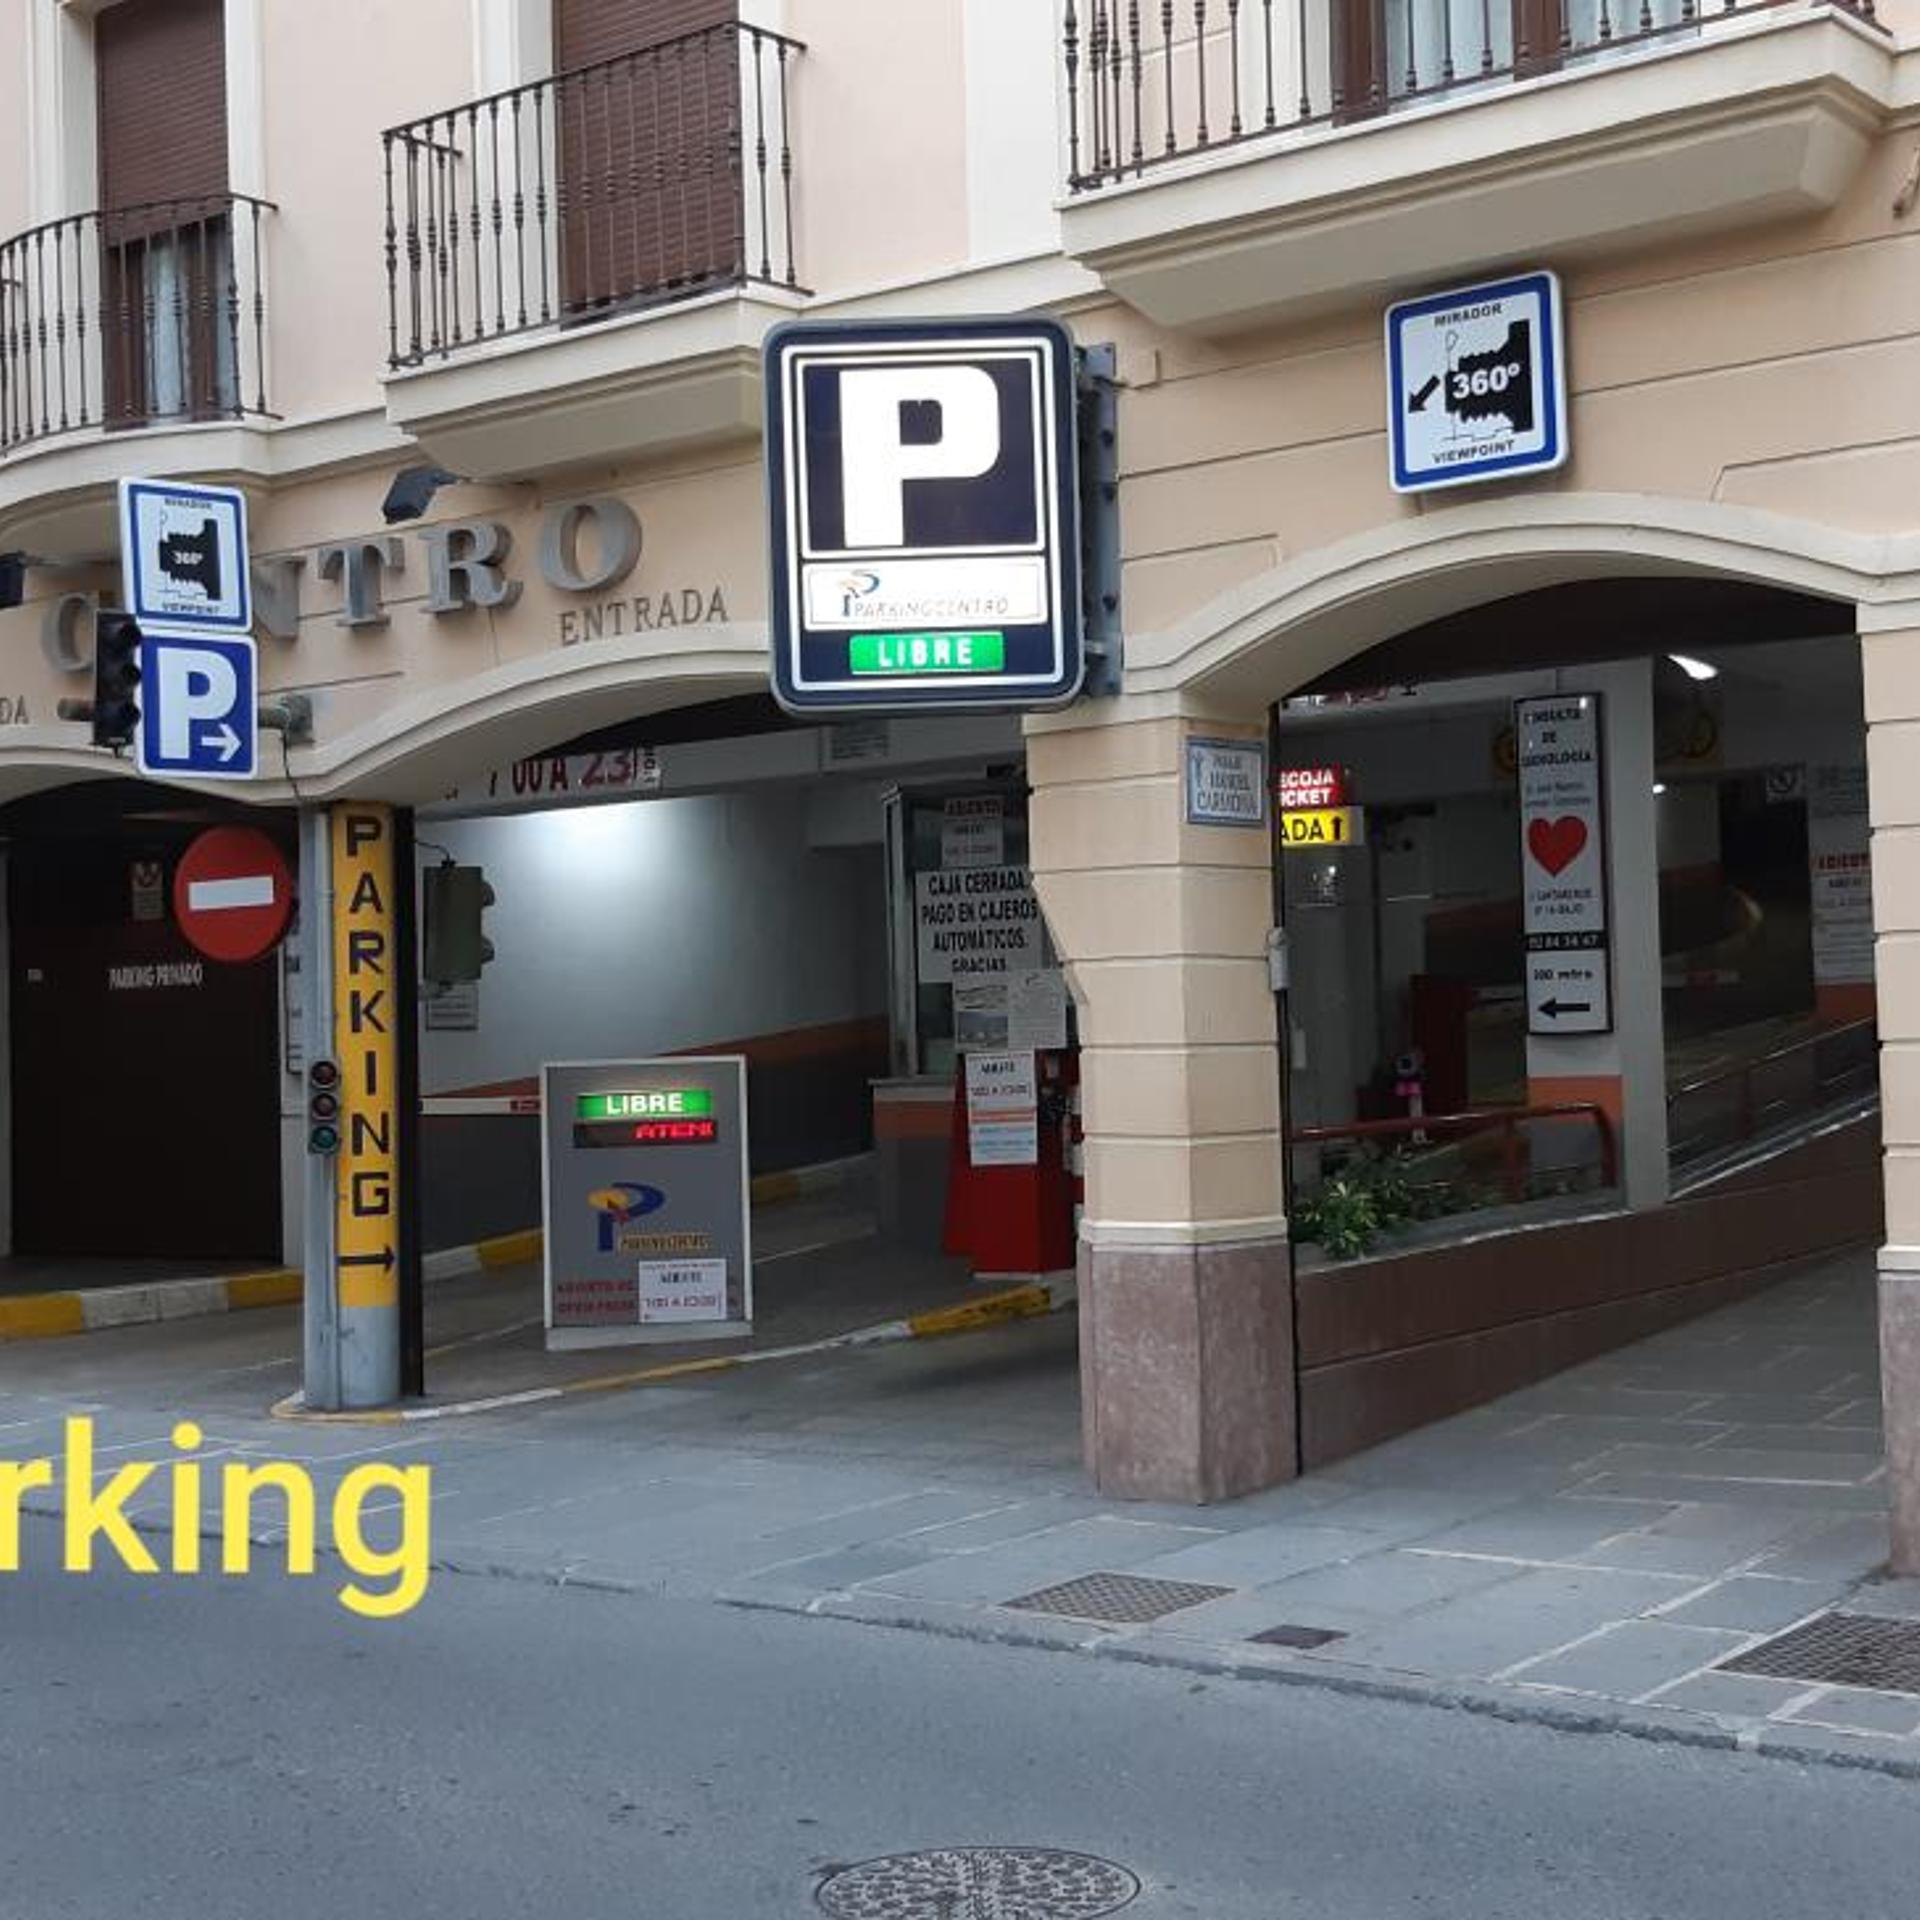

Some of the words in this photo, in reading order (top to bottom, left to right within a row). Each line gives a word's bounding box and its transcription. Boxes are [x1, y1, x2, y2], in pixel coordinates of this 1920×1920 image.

[1434, 303, 1502, 327] MIRADOR
[839, 366, 1000, 549] P
[1432, 440, 1515, 464] VIEWPOINT
[559, 586, 729, 647] ENTRADA
[877, 637, 973, 668] LIBRE
[156, 646, 238, 760] P
[928, 874, 961, 896] CAJA
[921, 901, 956, 925] PAGO
[958, 900, 977, 922] EN
[978, 895, 1038, 921] CAJEROS
[346, 815, 391, 1217] PARKING
[606, 1093, 684, 1115] LIBRE
